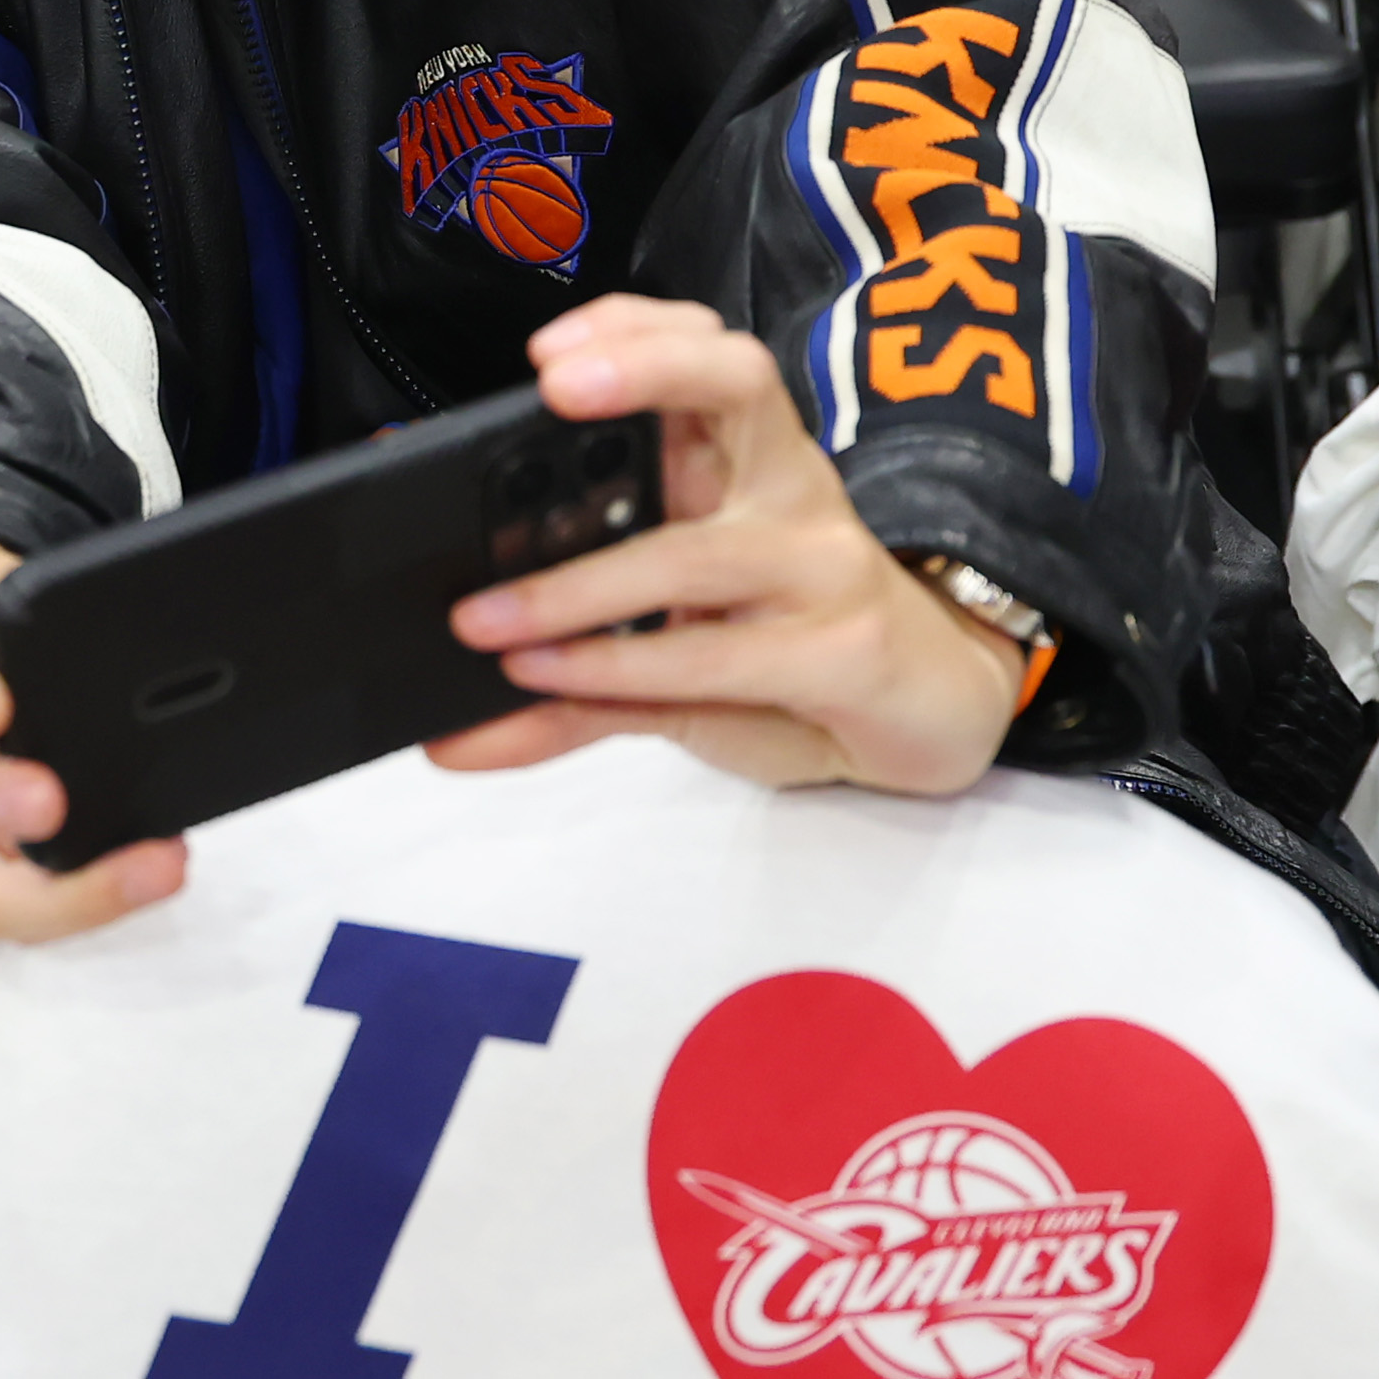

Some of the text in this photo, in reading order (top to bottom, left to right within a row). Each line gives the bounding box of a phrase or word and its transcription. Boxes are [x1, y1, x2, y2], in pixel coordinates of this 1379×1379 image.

[398, 53, 614, 218] KNICKS
[416, 42, 493, 95] NEW YORK
[145, 921, 582, 1379] I
[728, 1199, 1152, 1354] CAVALIERS
